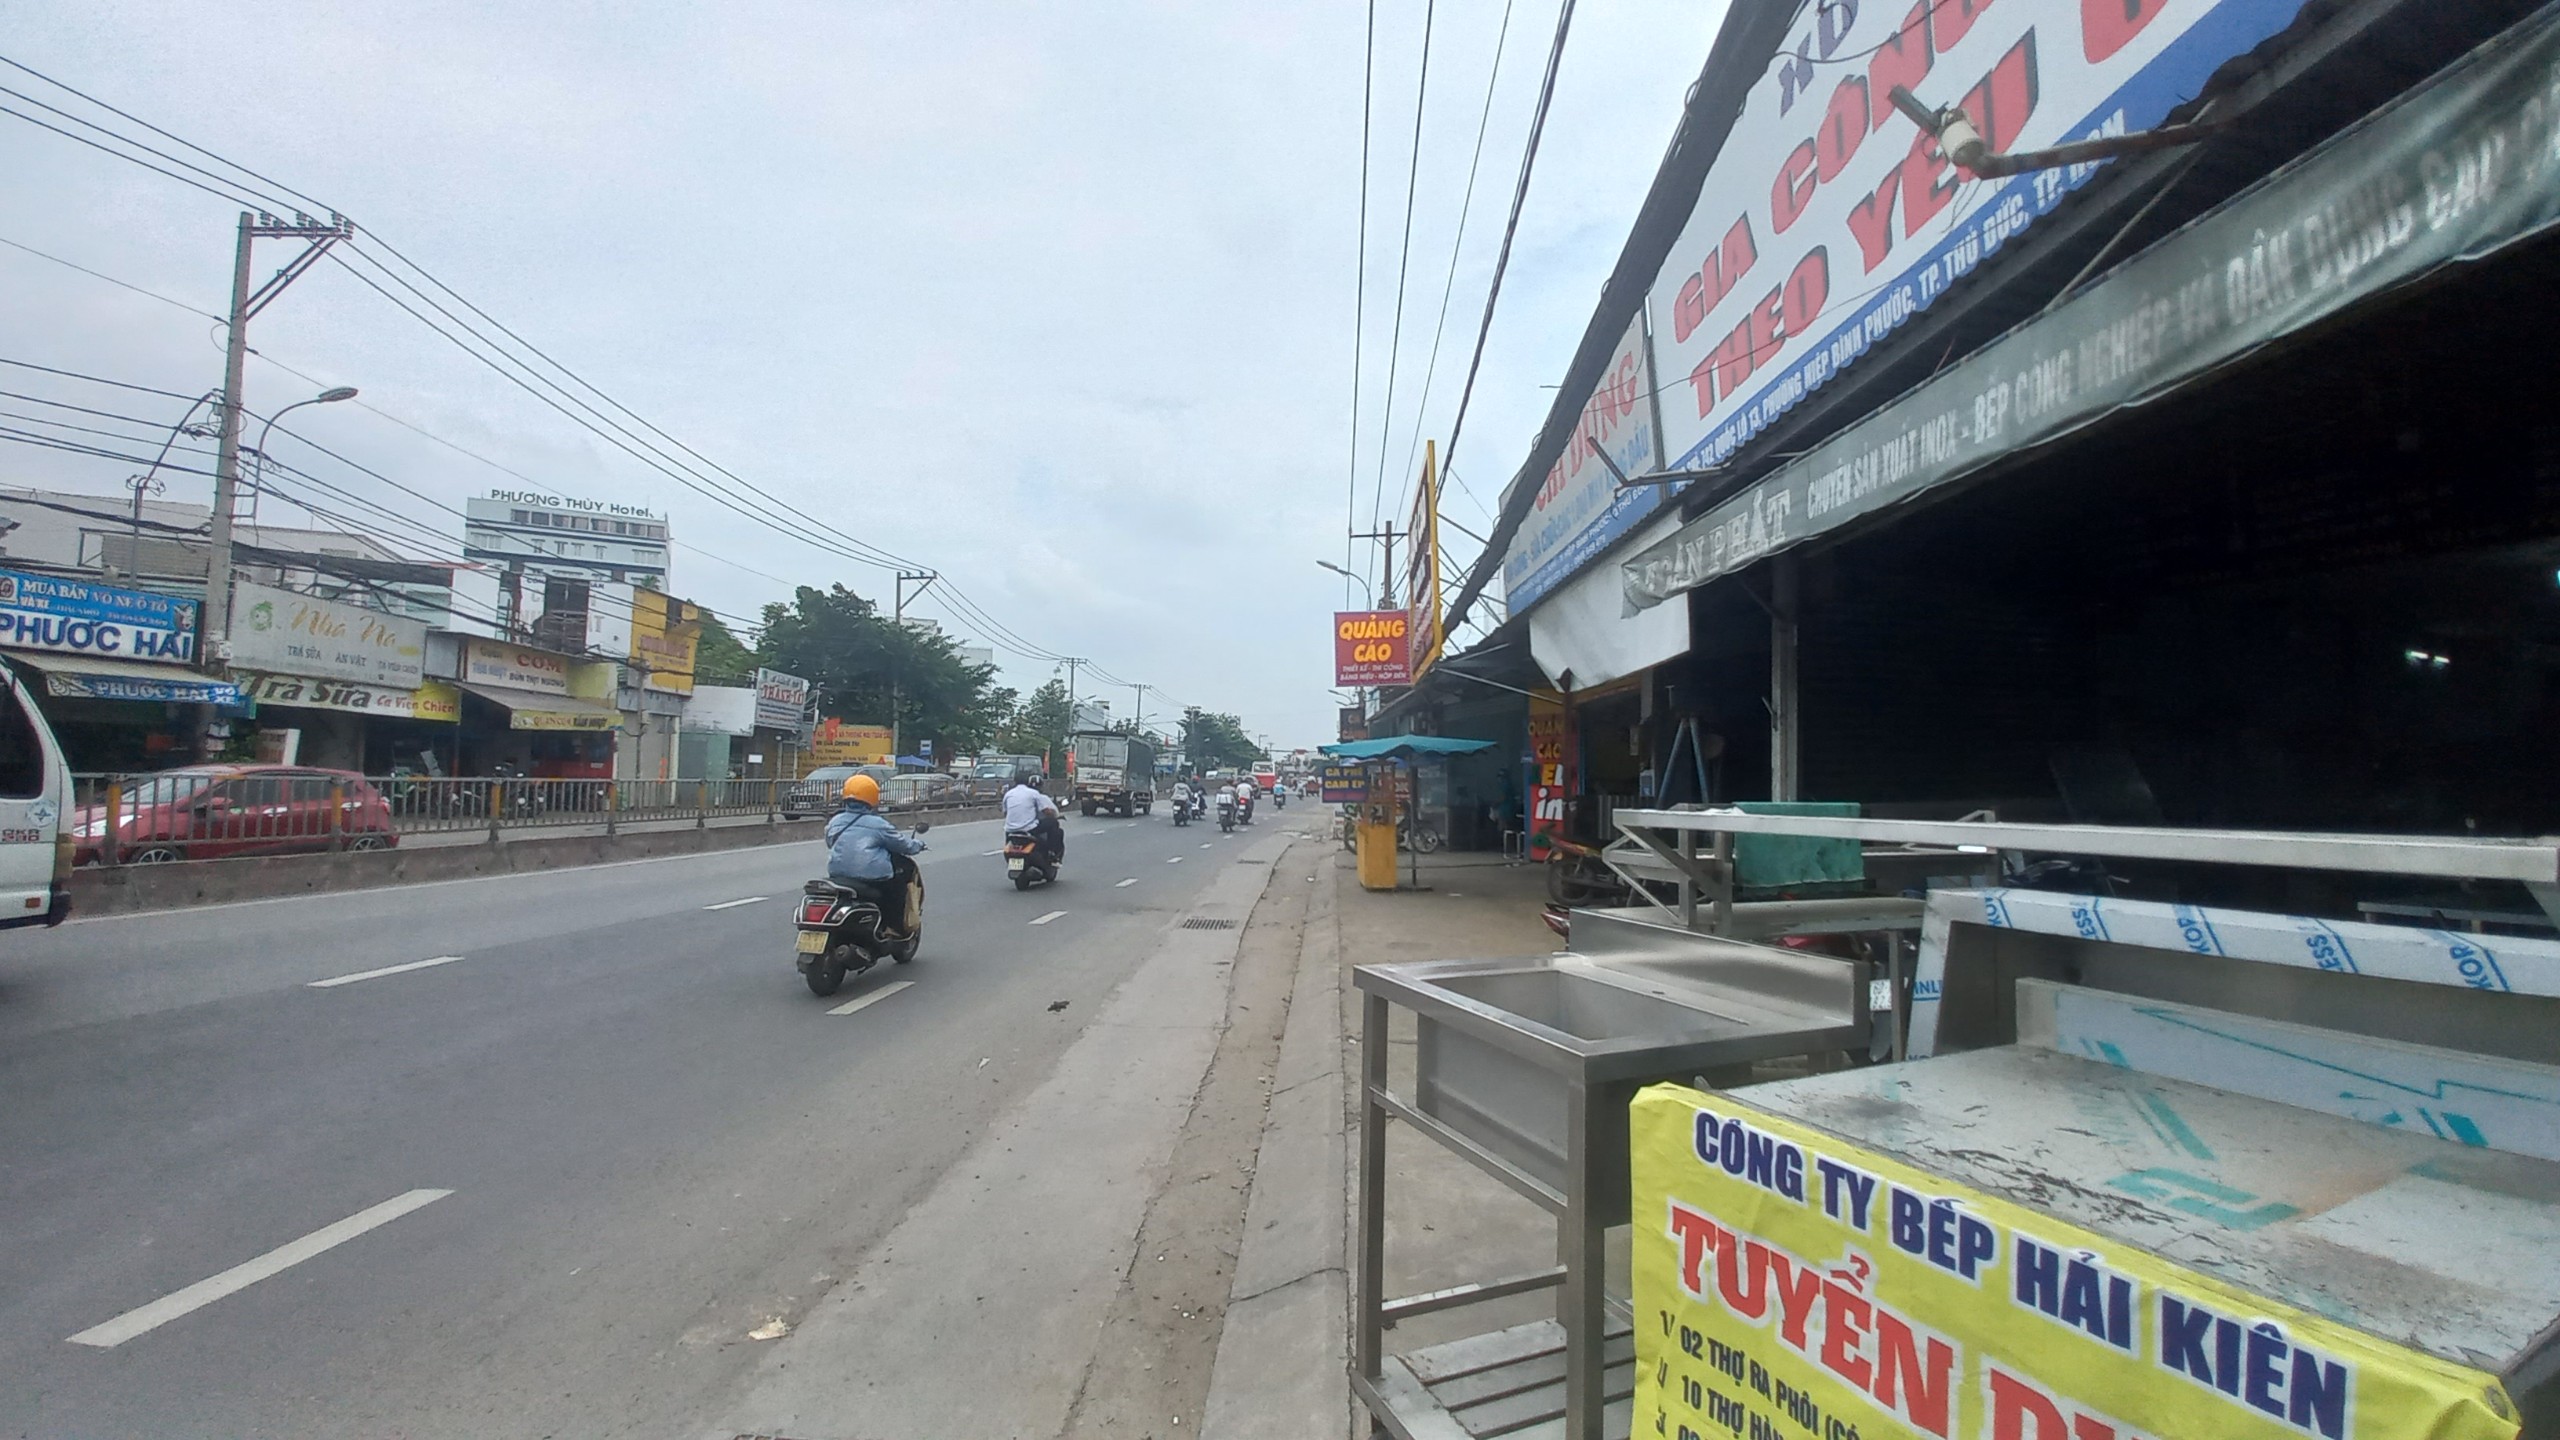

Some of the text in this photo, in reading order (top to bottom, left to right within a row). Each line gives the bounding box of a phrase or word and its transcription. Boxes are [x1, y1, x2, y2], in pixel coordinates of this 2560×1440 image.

[1674, 210, 1758, 343] GIA
[1831, 323, 1863, 369] BÌNH
[1918, 263, 1941, 301] TP.
[1942, 226, 1979, 281] THỦ
[1983, 193, 2030, 252] ĐỨC,
[2032, 167, 2064, 210] TP.
[1689, 244, 1830, 421] THEO
[1920, 409, 1957, 469] INOX
[491, 488, 650, 518] PHƯƠNG THÙY Hotel
[23, 579, 56, 597] MUA
[59, 583, 88, 601] BÁN
[0, 613, 122, 651] PHƯỚC
[133, 629, 192, 661] HẢI
[1338, 614, 1406, 641] QUẢNG
[1353, 639, 1392, 663] CÁO
[1695, 1112, 1804, 1202] CÔNG
[1816, 1157, 1876, 1231] TY
[1892, 1187, 1994, 1280] BẾP
[2016, 1236, 2132, 1351] HẢI
[2161, 1294, 2348, 1440] KIÊN
[1671, 1205, 1954, 1440] TUYỂN
[1680, 1325, 1703, 1361] 02
[1707, 1336, 1745, 1387] THỢ
[1750, 1358, 1772, 1402] RA
[1775, 1377, 1819, 1437] PHÔI
[1681, 1374, 1702, 1411] 10
[1706, 1387, 1745, 1440] THỢ
